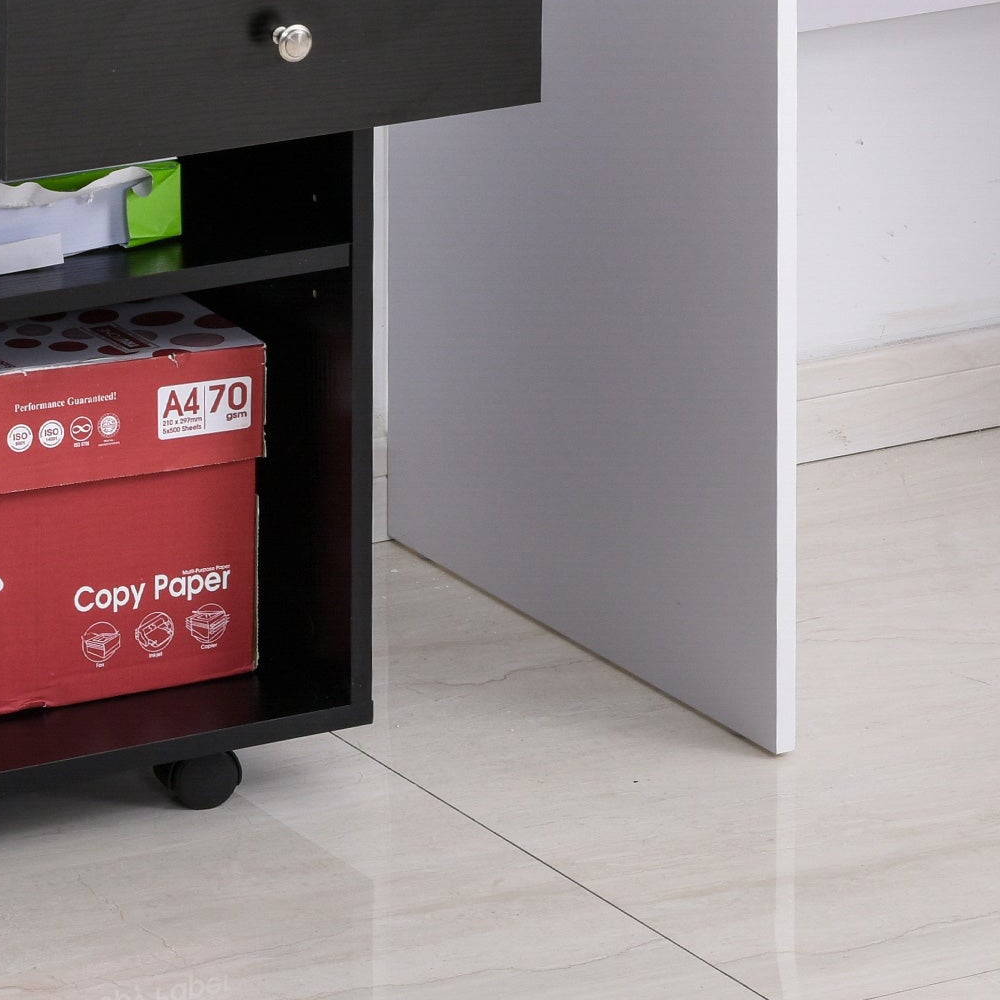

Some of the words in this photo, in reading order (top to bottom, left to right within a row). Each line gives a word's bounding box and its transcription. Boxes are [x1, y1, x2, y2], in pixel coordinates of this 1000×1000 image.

[14, 399, 65, 413] Performance
[67, 391, 117, 406] Guaranteed!
[162, 387, 200, 418] A4
[209, 382, 247, 413] 70
[180, 416, 202, 424] 297mm
[226, 411, 247, 421] gsm
[44, 428, 59, 437] ISO
[163, 426, 180, 434] 5x500
[13, 432, 28, 441] ISO
[74, 583, 146, 612] Copy
[155, 570, 231, 600] Paper
